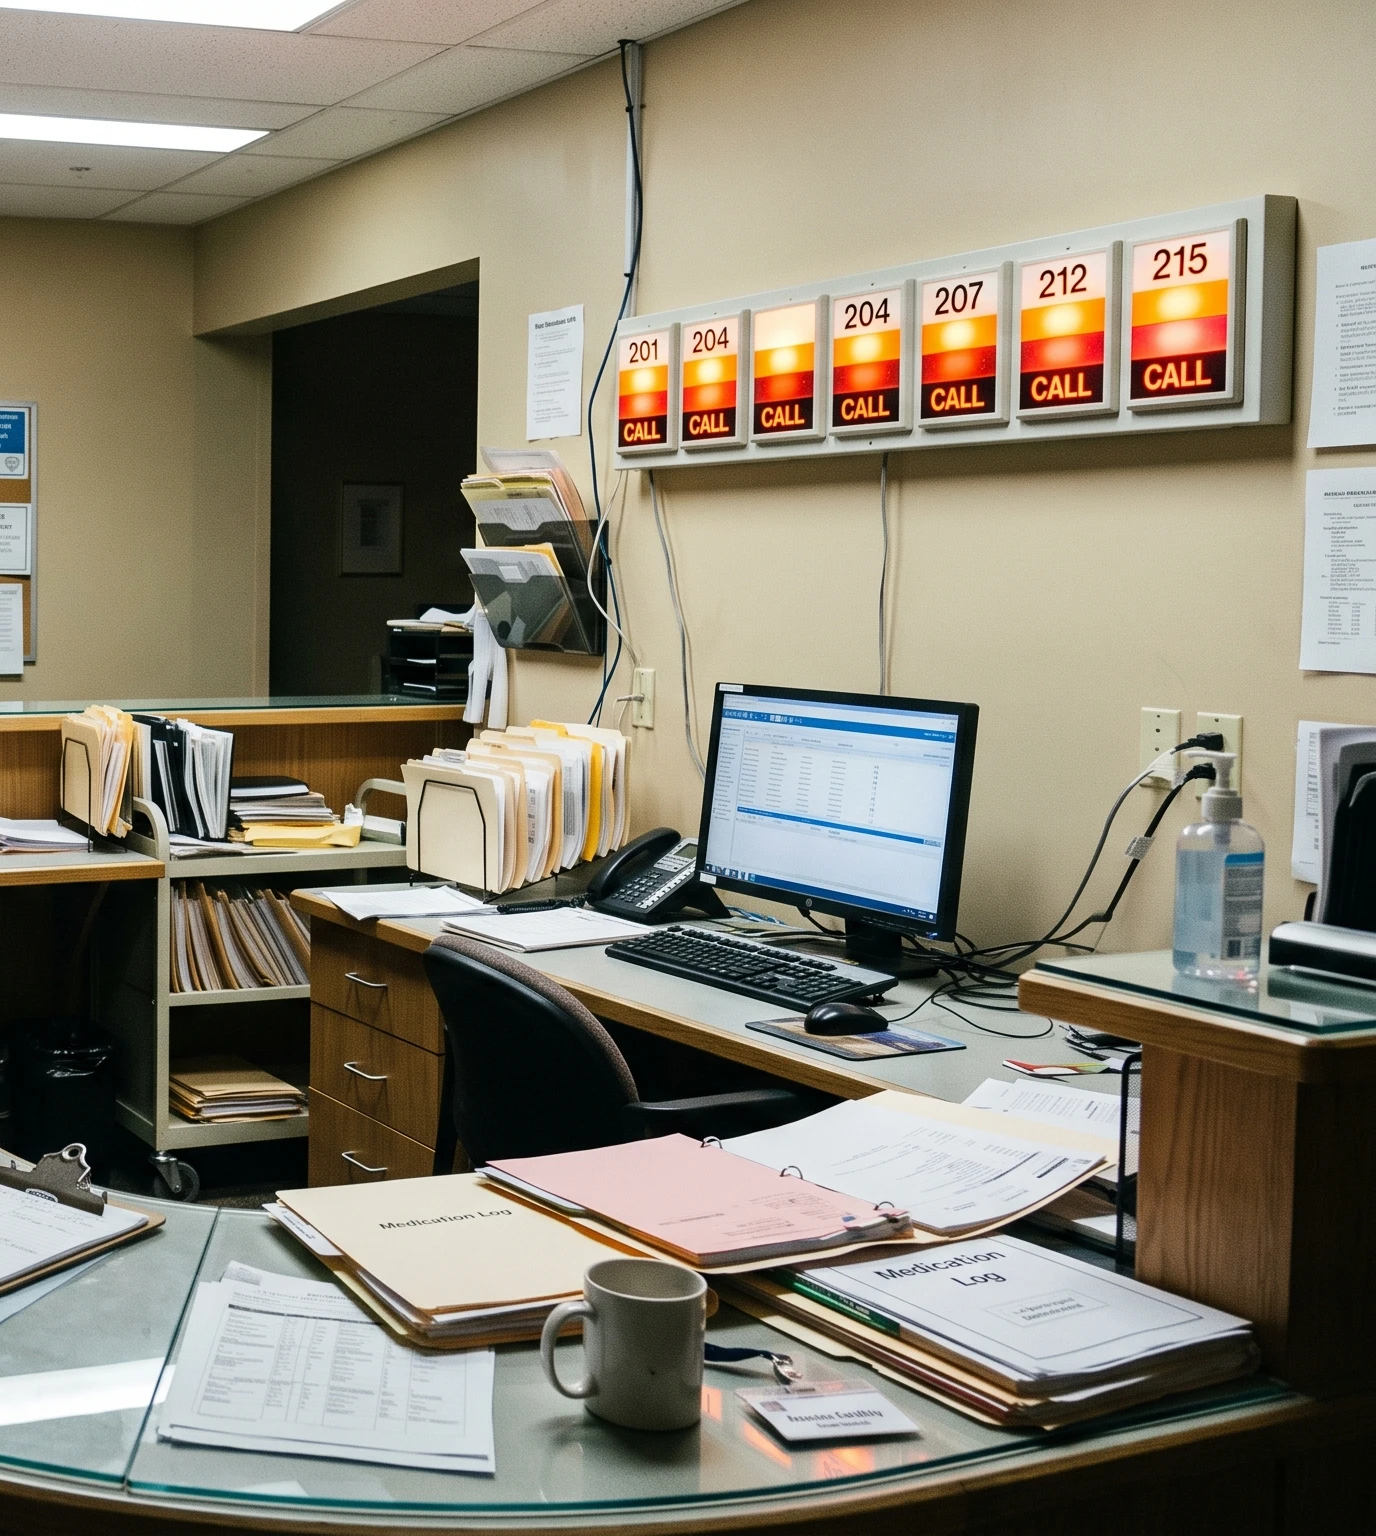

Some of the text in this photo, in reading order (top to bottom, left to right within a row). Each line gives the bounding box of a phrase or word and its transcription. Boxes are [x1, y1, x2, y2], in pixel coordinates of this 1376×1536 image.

[1151, 243, 1209, 282] 215
[1038, 263, 1088, 299] 212
[934, 281, 985, 316] 207
[843, 297, 891, 330] 204
[628, 338, 660, 364] 201
[691, 326, 730, 354] 204
[1031, 372, 1092, 402] CALL
[1143, 359, 1212, 391] CALL
[840, 394, 891, 421] CALL
[930, 384, 986, 412] CALL
[688, 412, 729, 436] CALL
[760, 403, 805, 428] CALL
[623, 420, 661, 442] CALL
[477, 1209, 512, 1217] Log
[873, 1251, 1006, 1280] Medication
[950, 1272, 1007, 1287] Log
